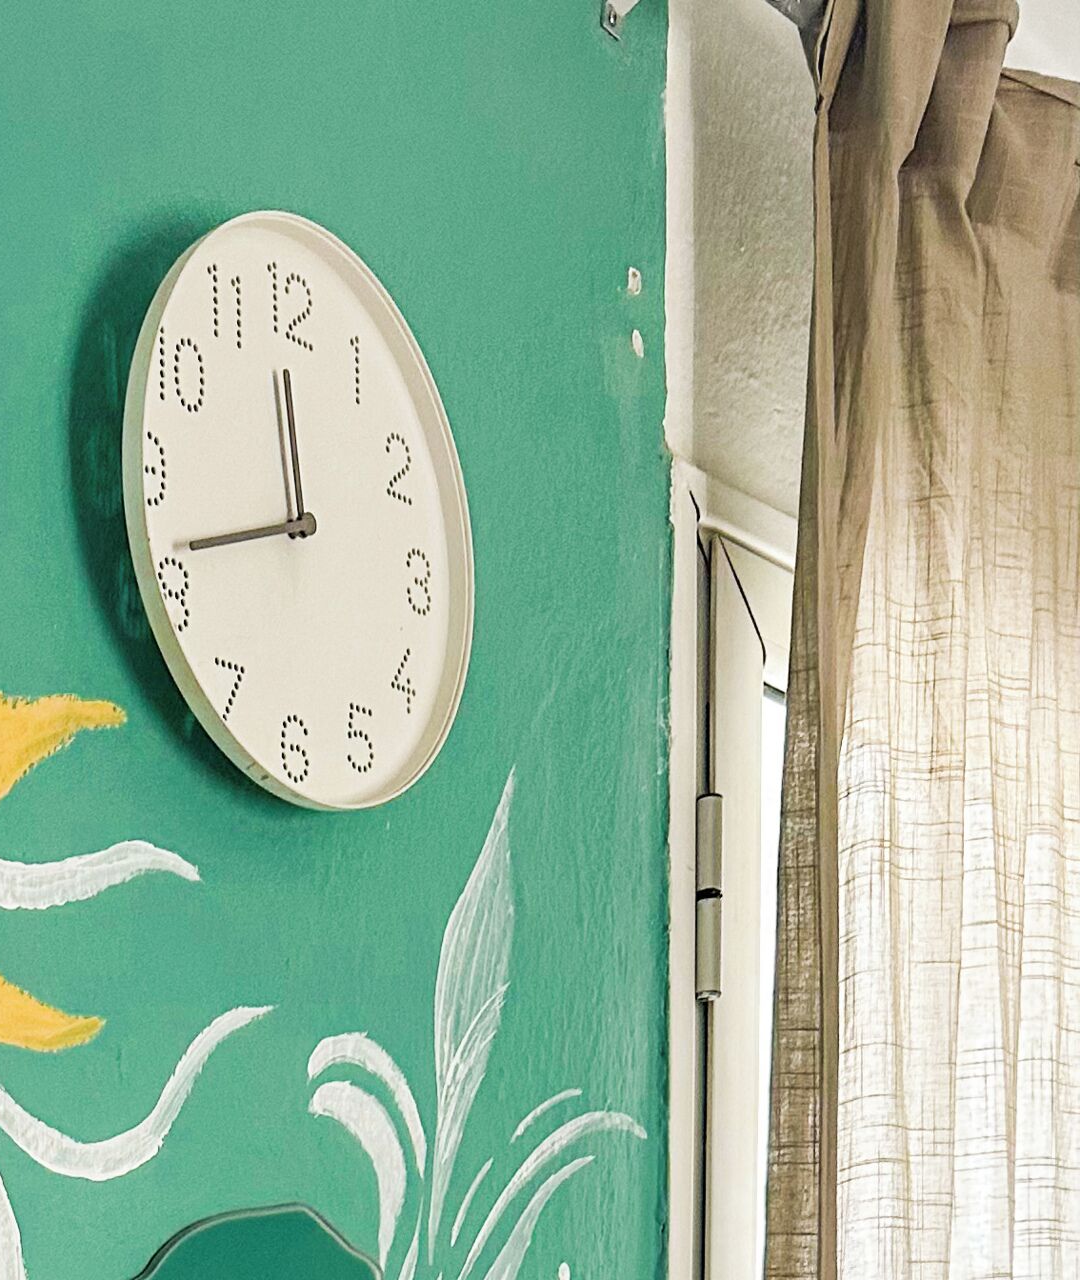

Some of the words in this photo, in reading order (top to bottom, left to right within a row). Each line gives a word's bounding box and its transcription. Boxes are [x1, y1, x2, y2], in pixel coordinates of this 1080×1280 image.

[207, 263, 242, 349] 11
[267, 261, 314, 352] 12
[159, 326, 205, 413] 10
[349, 335, 361, 405] 1
[385, 432, 411, 506] 2
[406, 548, 431, 616] 3
[214, 657, 245, 721] 7
[390, 648, 416, 714] 4
[281, 714, 309, 783] 6
[346, 702, 374, 773] 5
